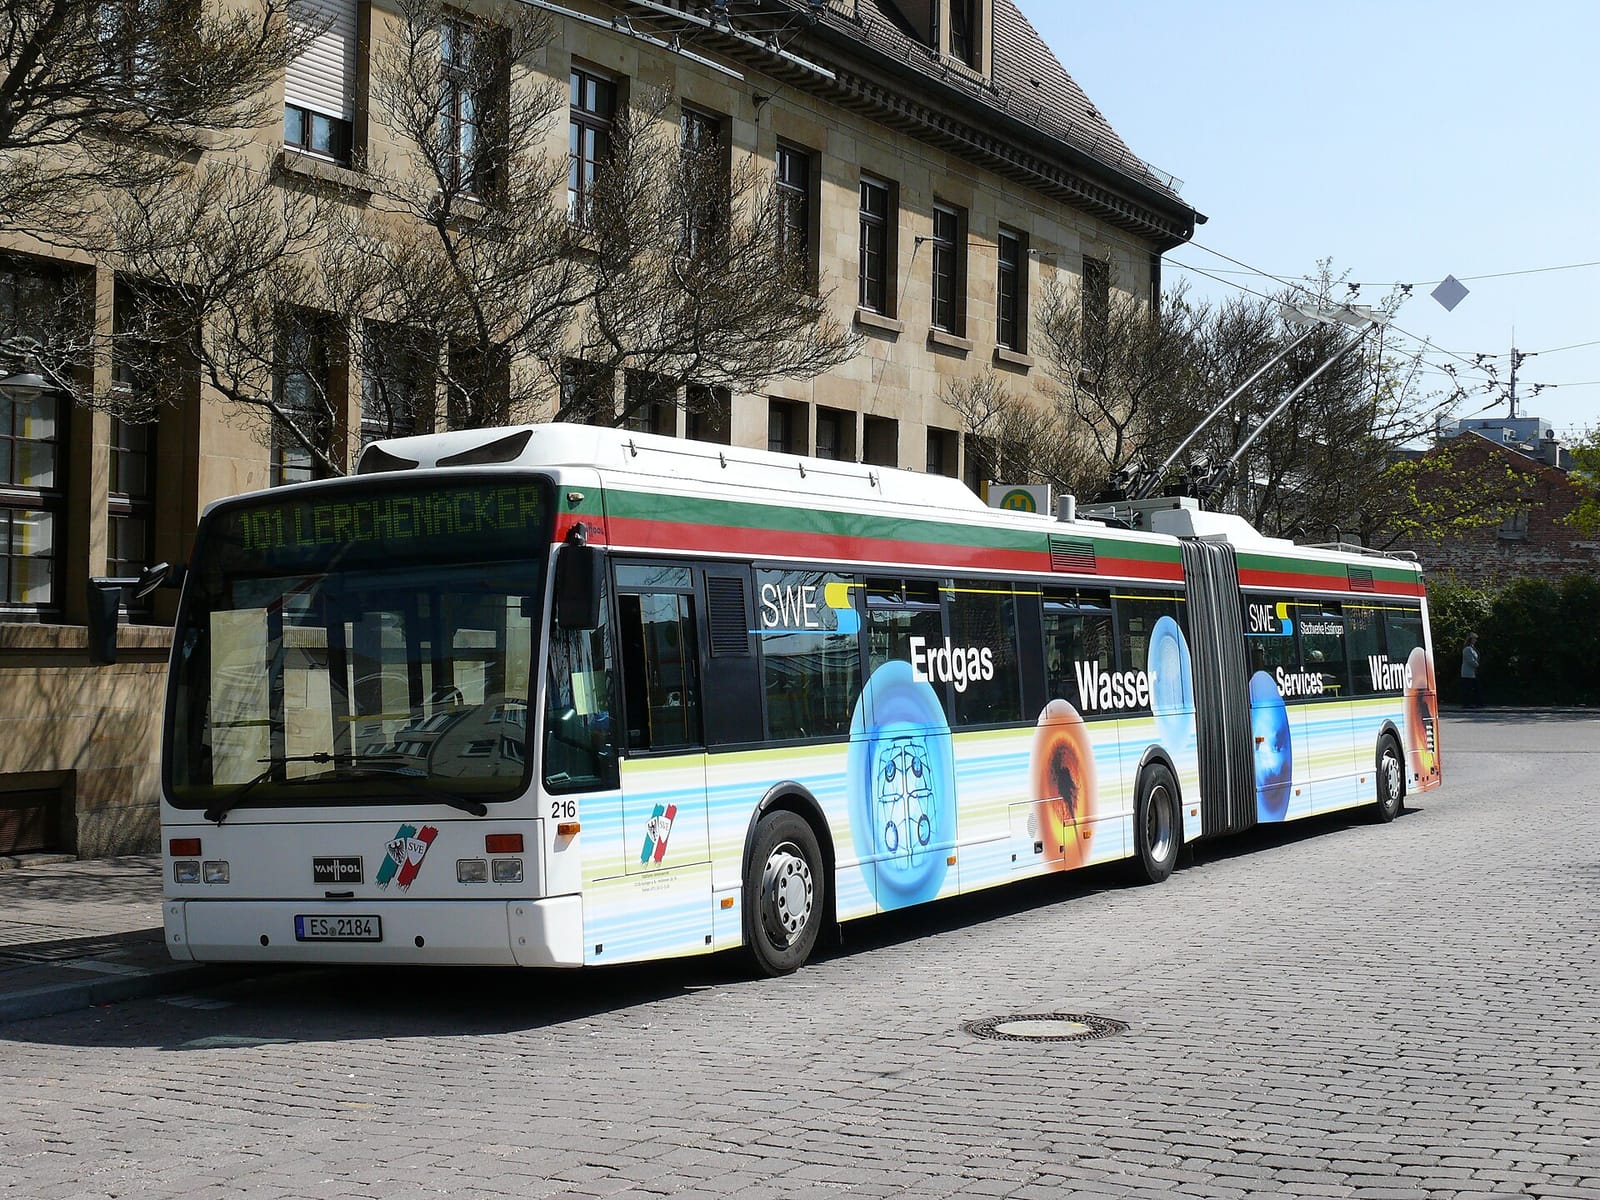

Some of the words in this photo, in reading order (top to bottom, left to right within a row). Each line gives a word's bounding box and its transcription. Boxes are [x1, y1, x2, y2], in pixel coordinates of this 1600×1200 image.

[239, 510, 286, 550] 101
[295, 486, 540, 546] LERCHENÄCKER
[761, 583, 819, 628] SWE
[1249, 603, 1275, 632] SWE
[1300, 621, 1324, 635] Stadtwerke
[909, 636, 994, 692] Erdgas
[1367, 654, 1412, 691] Wärme
[1074, 660, 1157, 711] Wasser
[1275, 665, 1323, 697] Services
[551, 801, 576, 819] 216
[408, 842, 424, 855] SVE
[310, 919, 328, 936] ES
[337, 919, 372, 937] 2184
